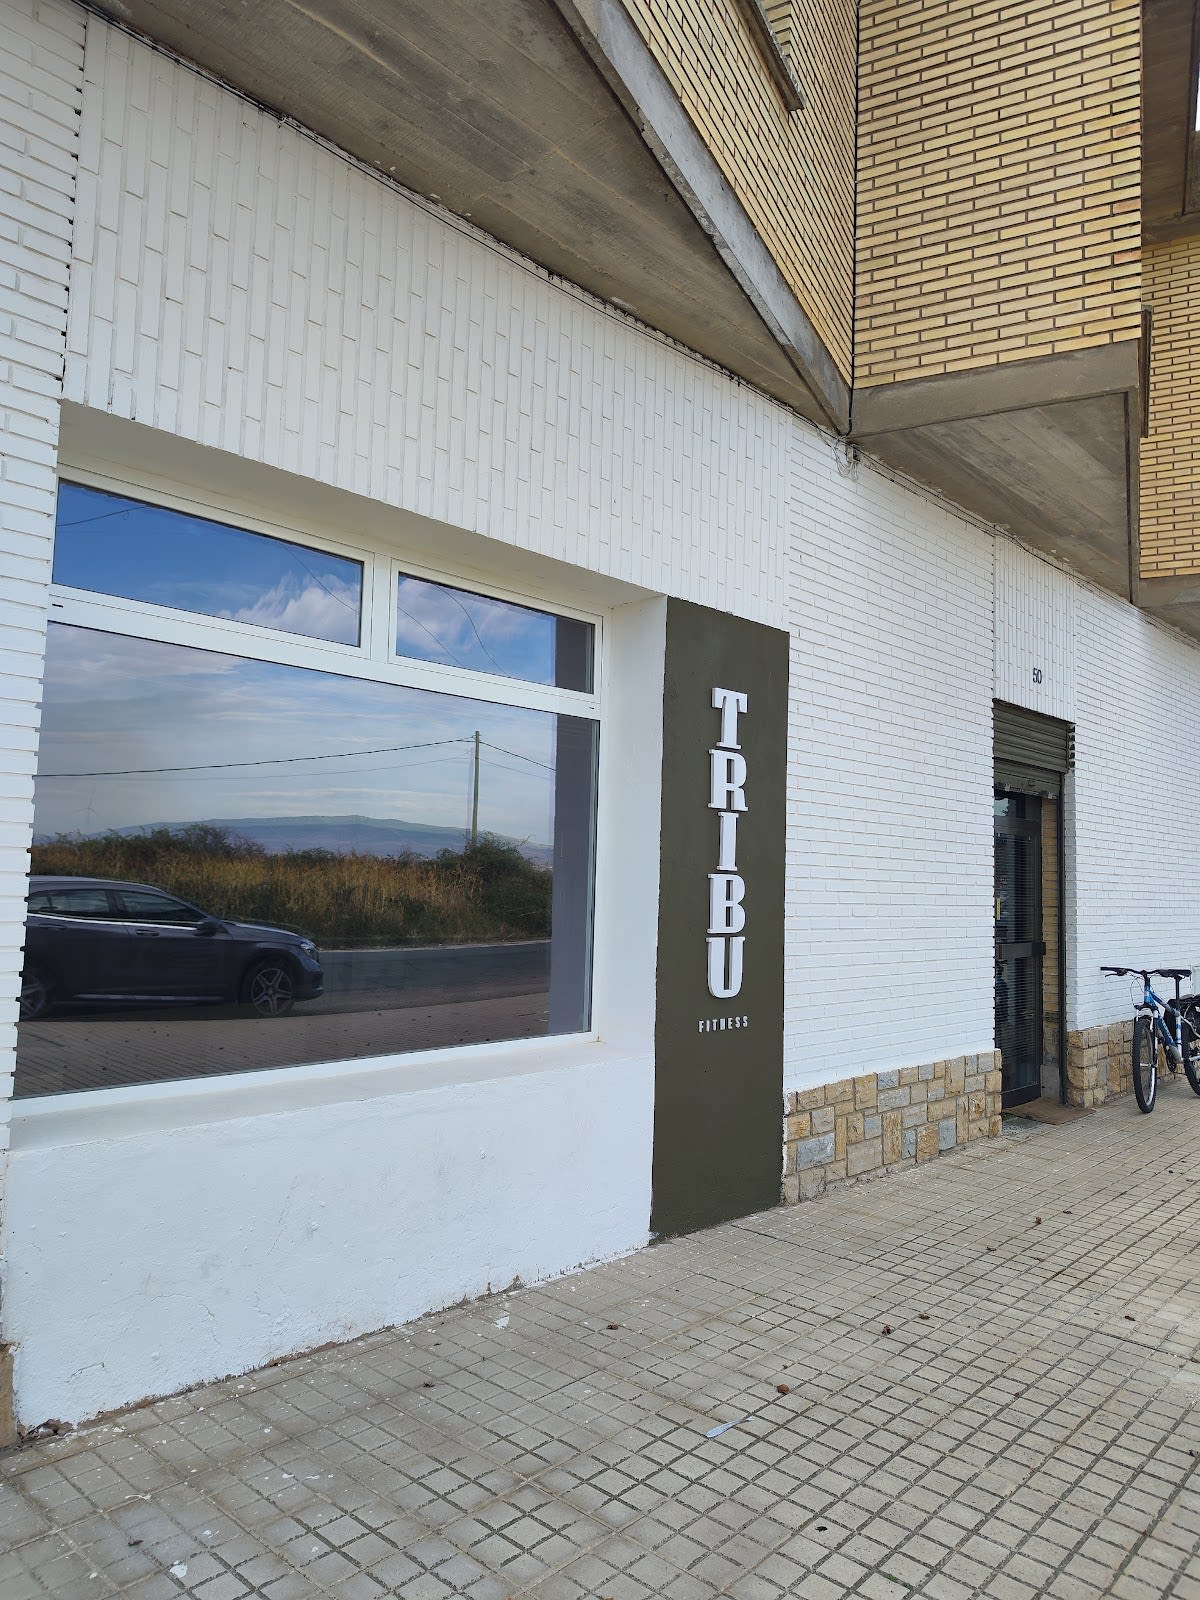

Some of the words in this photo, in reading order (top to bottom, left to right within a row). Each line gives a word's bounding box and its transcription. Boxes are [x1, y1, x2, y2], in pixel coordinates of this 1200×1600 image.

[1032, 667, 1043, 685] 50
[706, 687, 748, 998] TRIBU
[698, 1015, 748, 1033] FITNESS
